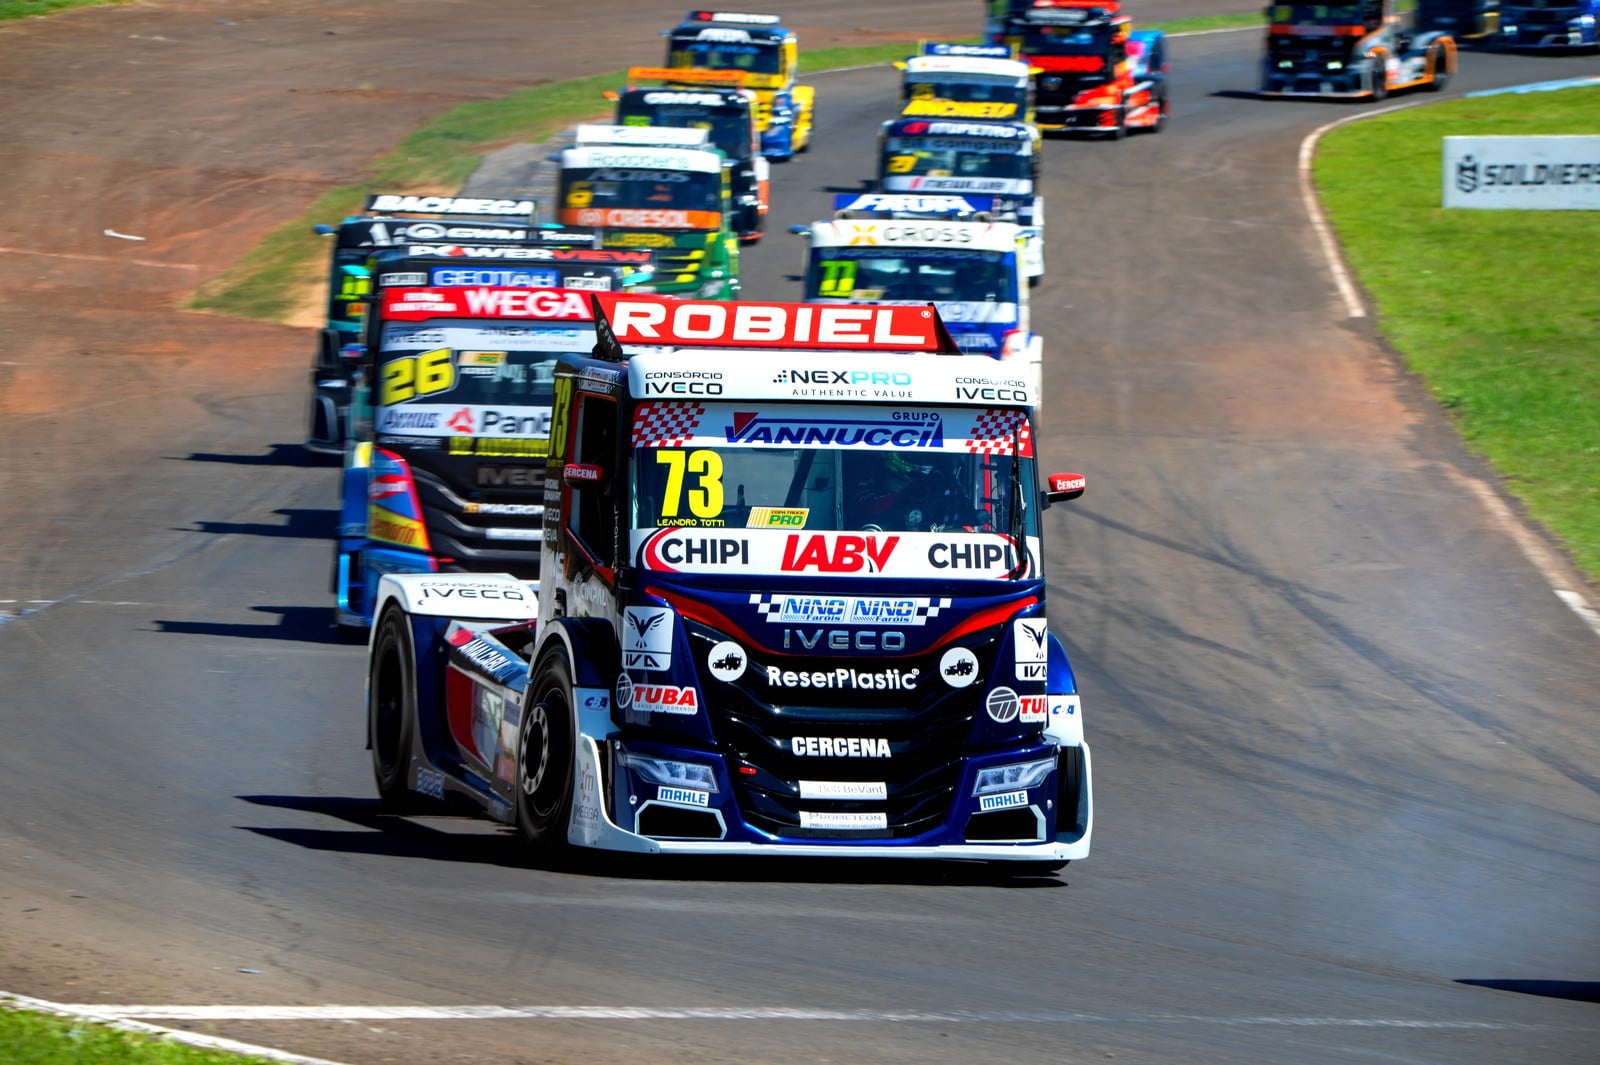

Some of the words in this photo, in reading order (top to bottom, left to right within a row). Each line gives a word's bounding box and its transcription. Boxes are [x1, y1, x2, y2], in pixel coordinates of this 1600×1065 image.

[607, 210, 694, 229] CRESOL
[883, 226, 973, 243] CROSS
[465, 288, 592, 319] WEGA
[613, 301, 926, 345] ROBIEL
[381, 347, 455, 407] 26
[790, 369, 912, 386] NEXPRO
[645, 381, 723, 395] IVECO
[792, 388, 868, 397] AUTHENTIC
[874, 389, 914, 398] VALUE
[956, 387, 1028, 402] IVECO
[892, 411, 940, 422] GRUPO
[477, 466, 545, 486] IVEC
[564, 465, 598, 480] CERCENA
[656, 449, 724, 517] 73
[657, 518, 697, 527] LEANDRO
[700, 519, 725, 527] TOTTI
[769, 515, 803, 526] PRO
[660, 537, 750, 565] CHIPI
[928, 542, 1010, 570] CHIPI
[424, 588, 524, 600] IVECO
[784, 629, 906, 650] IVECO
[625, 653, 660, 668] IVA
[767, 665, 918, 690] ReserPlastic
[634, 686, 696, 706] TUBA
[1020, 698, 1046, 714] TU
[1052, 704, 1075, 715] CA
[791, 736, 892, 758] CERCENA
[660, 788, 707, 805] MAHLE
[982, 793, 1026, 809] MAHLE
